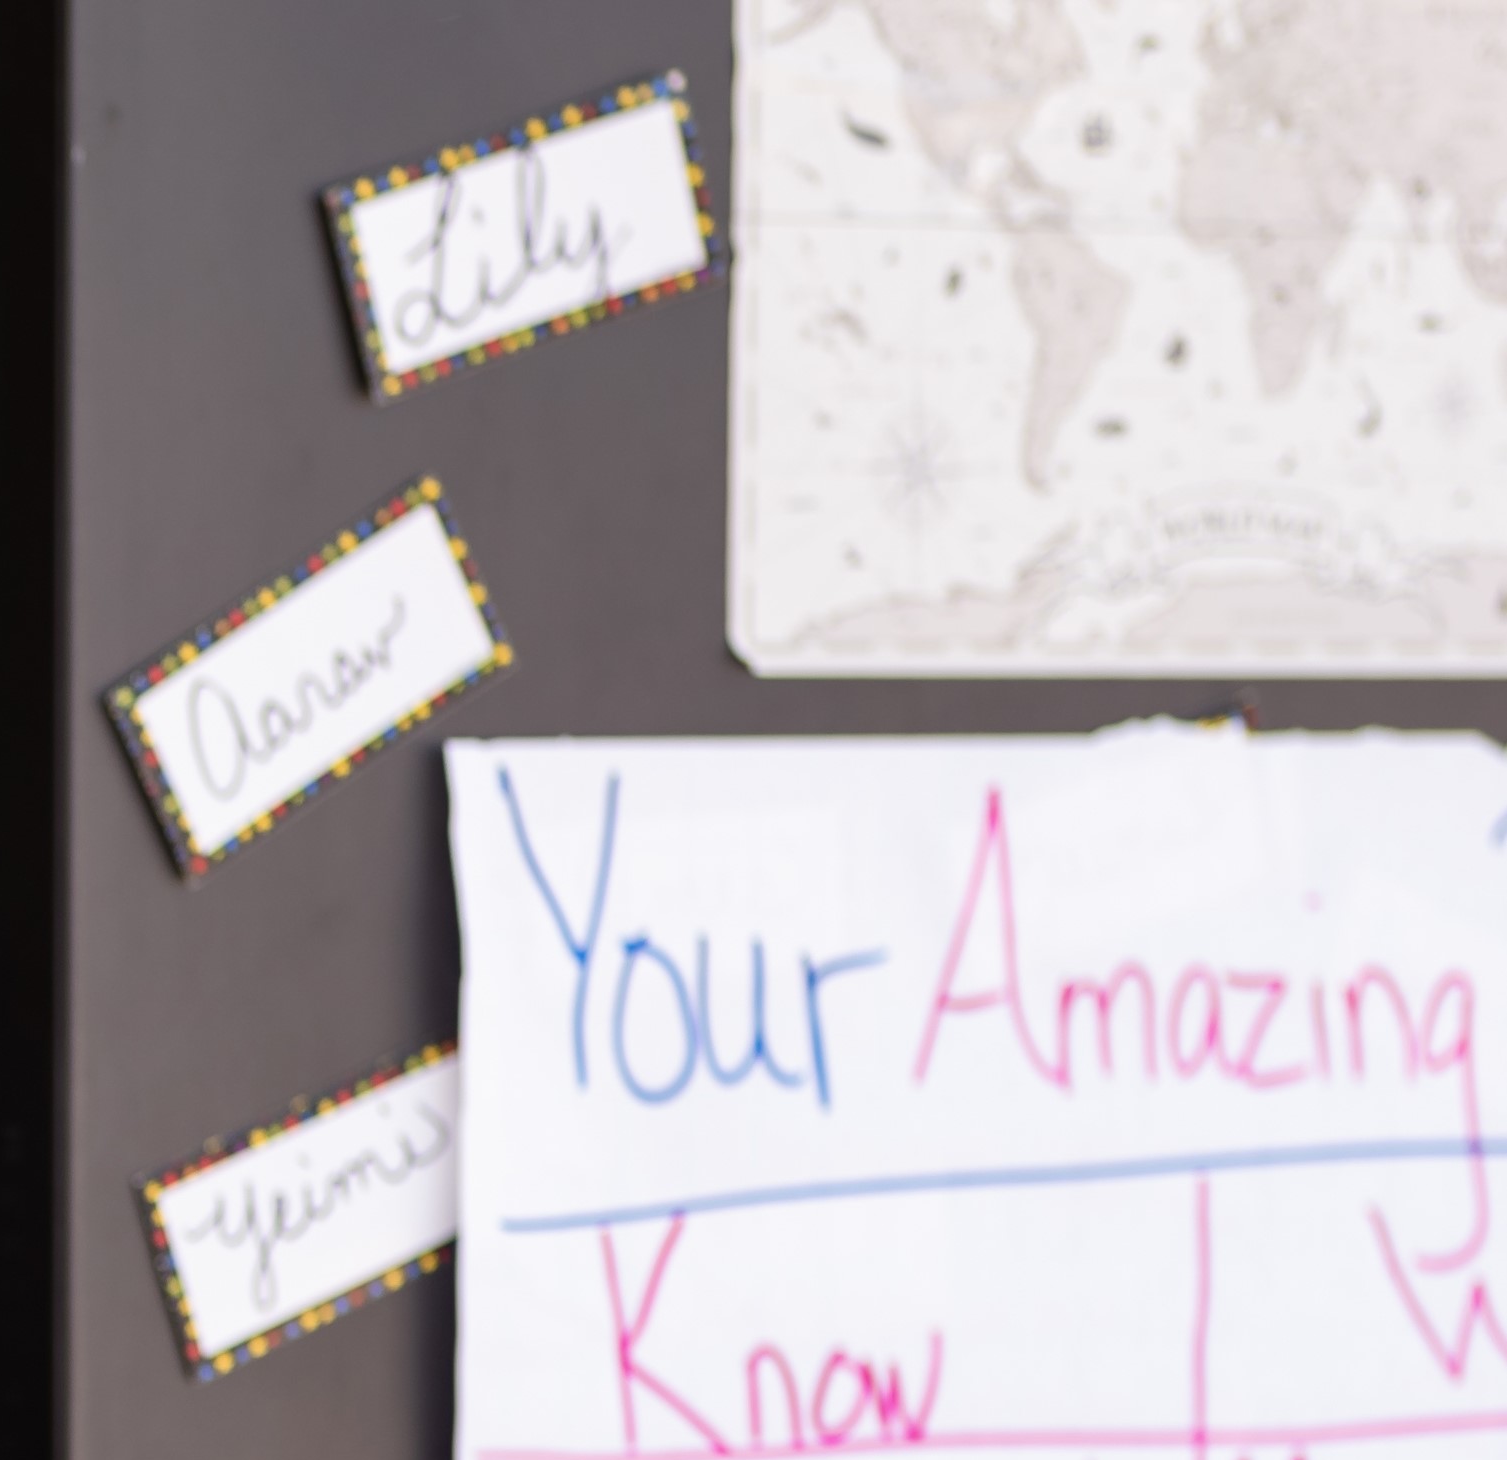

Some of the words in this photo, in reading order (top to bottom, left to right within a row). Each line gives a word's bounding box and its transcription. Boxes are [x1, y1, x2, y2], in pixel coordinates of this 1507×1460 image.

[393, 142, 636, 348] Lily
[491, 760, 890, 1118] Your
[910, 780, 1492, 1277] Amazing
[596, 1210, 946, 1460] Know
